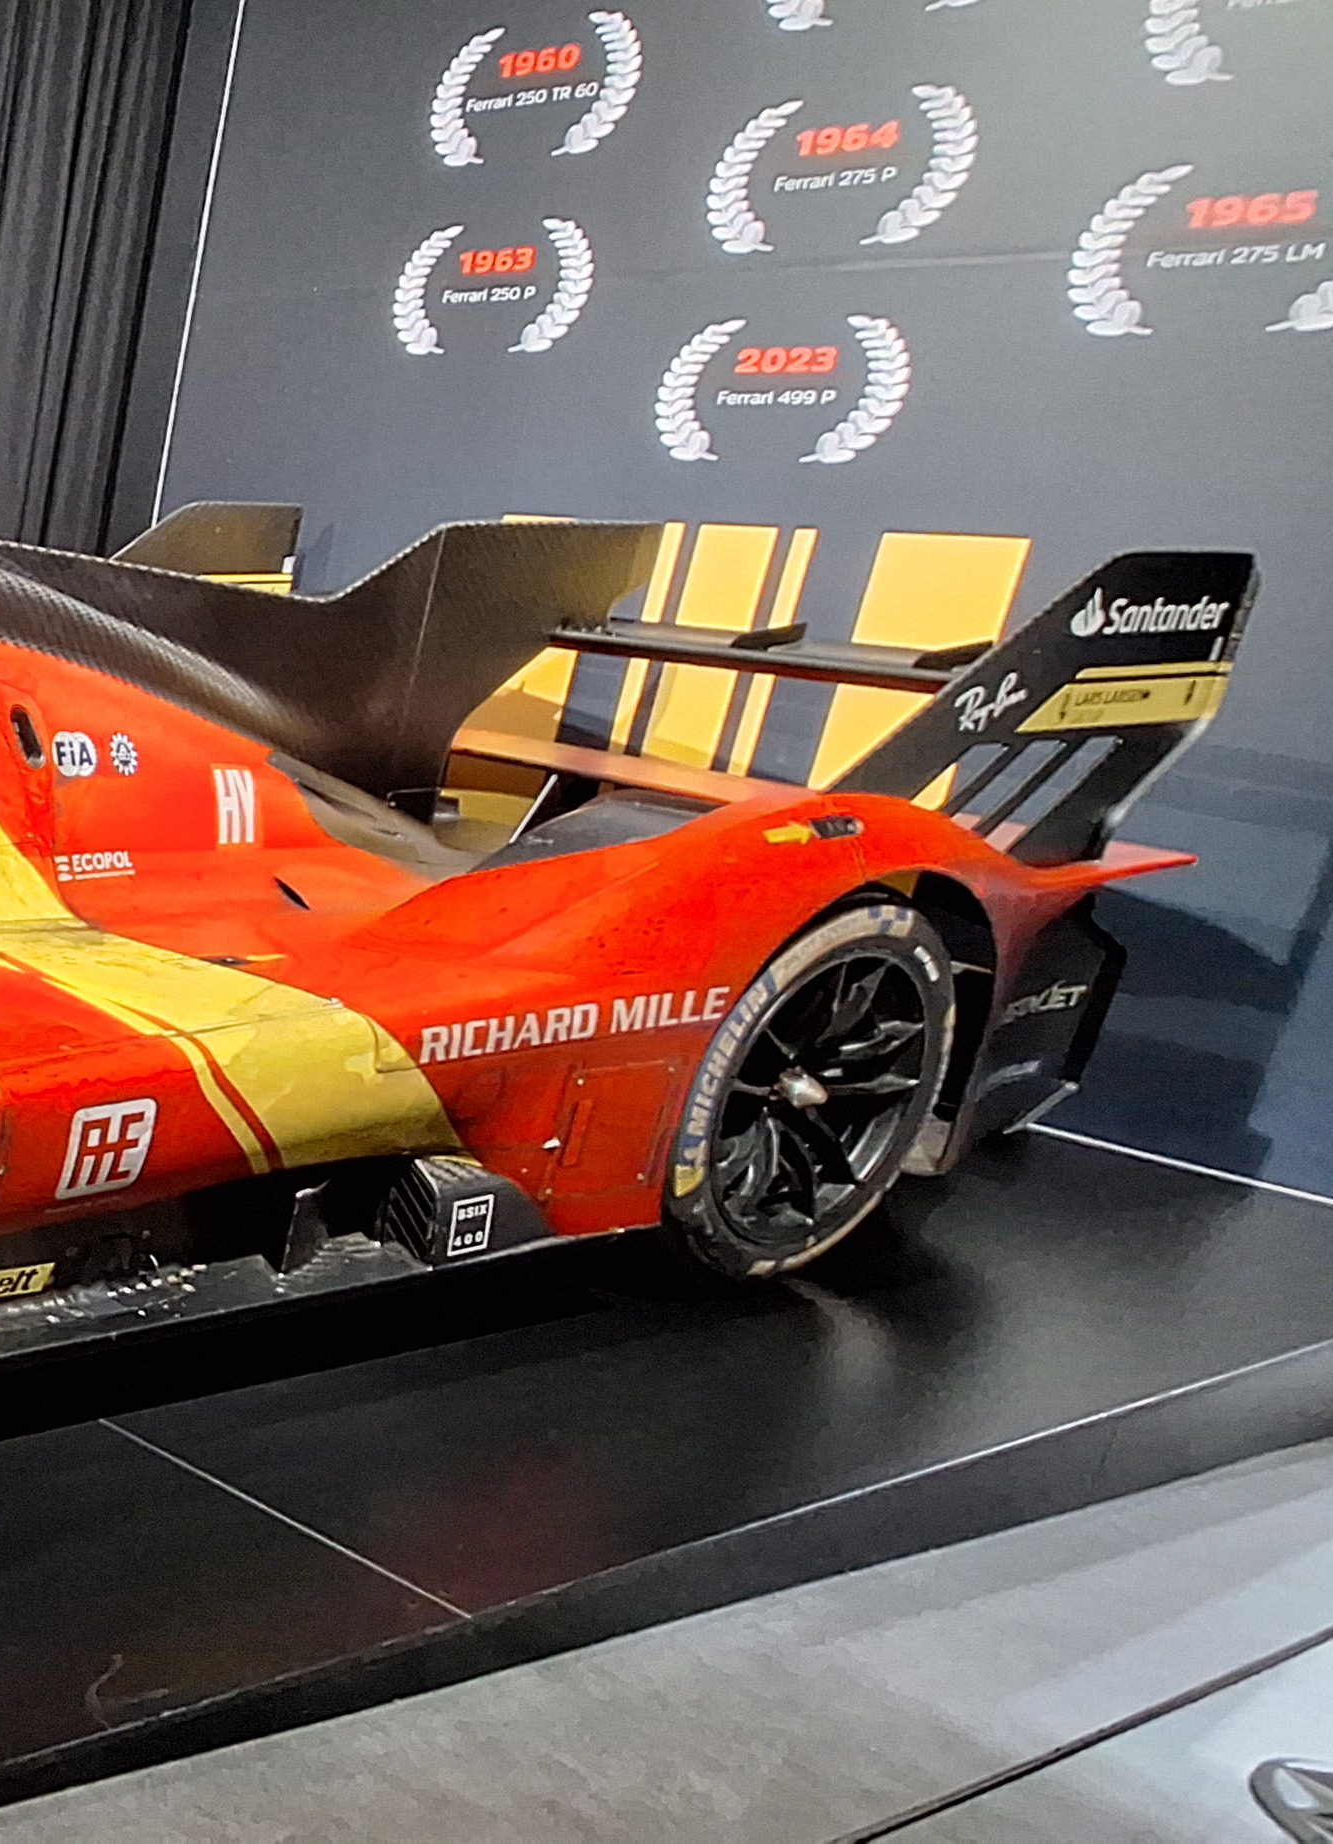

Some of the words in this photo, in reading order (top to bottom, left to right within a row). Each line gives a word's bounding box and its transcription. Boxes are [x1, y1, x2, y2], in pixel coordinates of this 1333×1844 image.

[498, 43, 581, 78] 1960
[465, 94, 513, 113] Ferrari
[515, 87, 547, 106] 250
[552, 85, 572, 102] TR
[574, 81, 599, 98] 60
[796, 120, 901, 156] 1964
[773, 172, 834, 192] Ferrari
[838, 167, 876, 187] 275
[881, 166, 898, 183] P
[1186, 190, 1318, 229] 1965
[459, 246, 537, 275] 1963
[1146, 248, 1225, 270] Ferrari
[1231, 246, 1280, 264] 275
[1285, 242, 1326, 262] LM
[442, 288, 487, 304] Ferrari
[490, 286, 521, 302] 250
[523, 285, 537, 300] P
[734, 345, 838, 374] 2023
[717, 390, 773, 406] Ferrari
[776, 389, 816, 405] 499
[820, 388, 837, 404] P
[1102, 595, 1230, 635] Santander
[213, 768, 255, 844] HY
[71, 851, 133, 873] ECOPOL
[419, 1003, 599, 1064] RICHARD
[610, 986, 730, 1034] MILLE
[687, 981, 769, 1137] MICHELIN
[453, 1230, 484, 1247] 400
